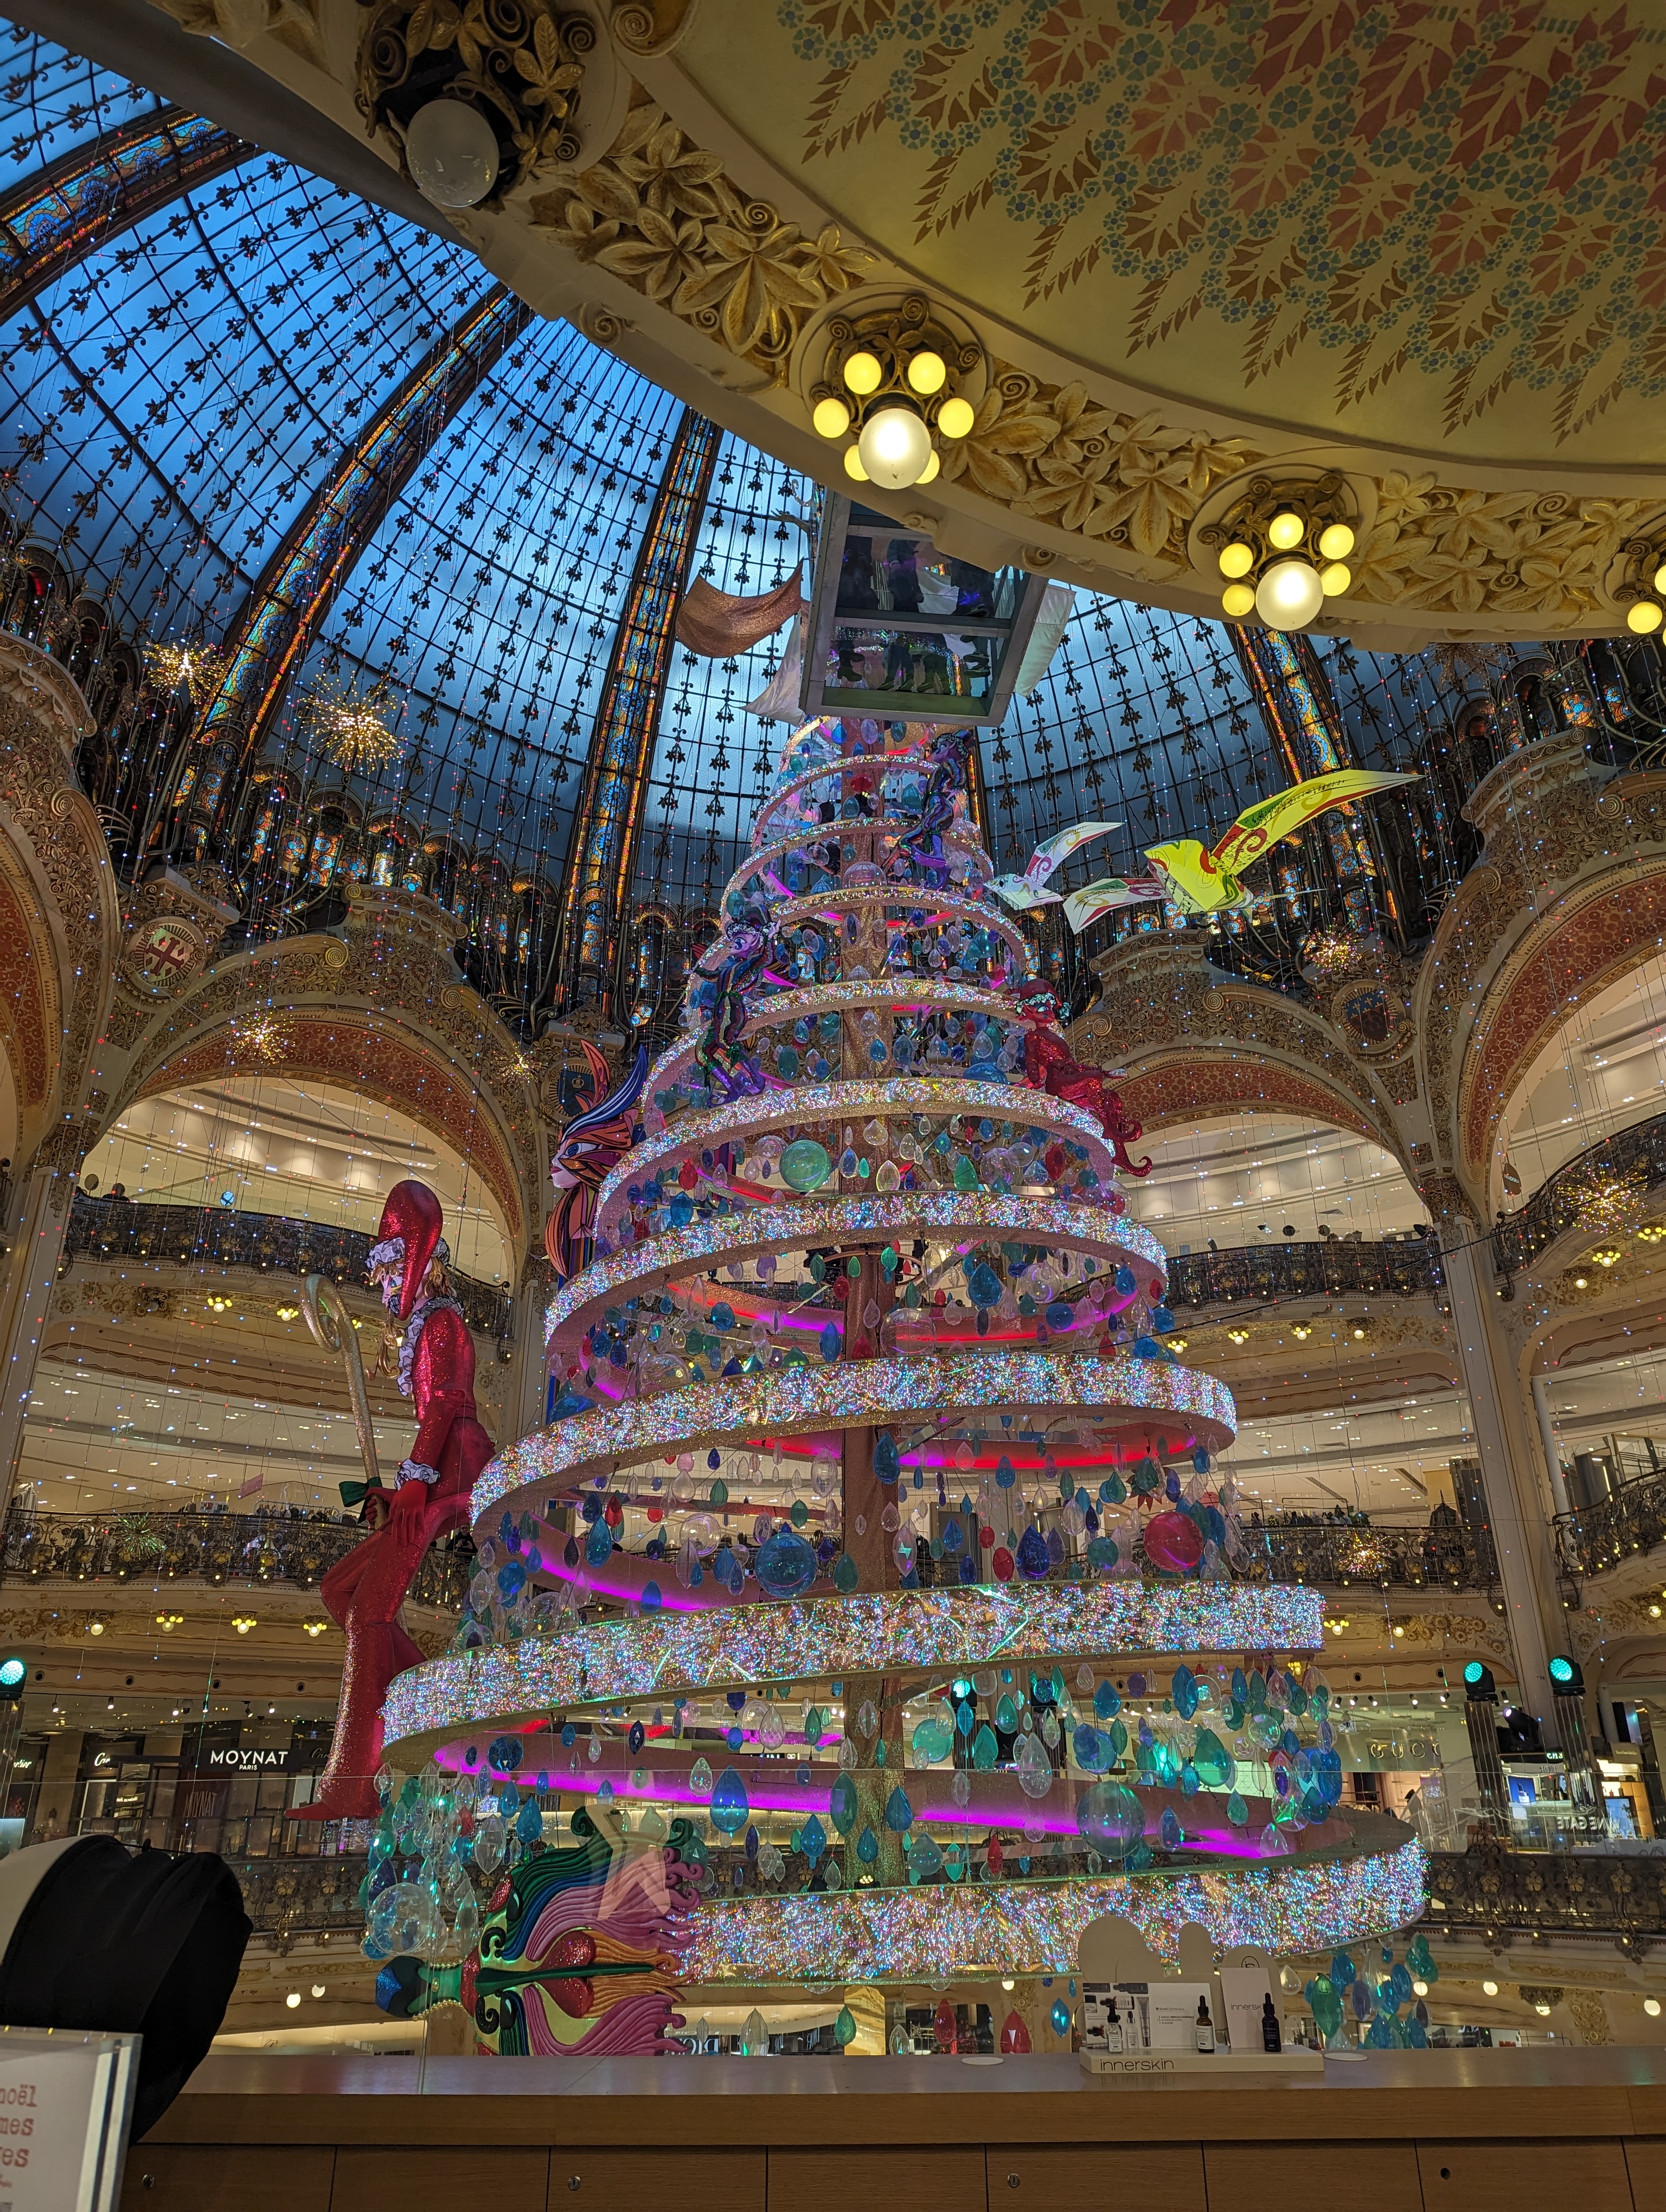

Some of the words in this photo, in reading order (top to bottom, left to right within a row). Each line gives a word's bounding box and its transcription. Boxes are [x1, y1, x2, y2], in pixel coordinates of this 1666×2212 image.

[210, 1750, 289, 1765] MOYNAT
[1100, 2059, 1174, 2072] innerskin
[0, 2146, 30, 2168] es
